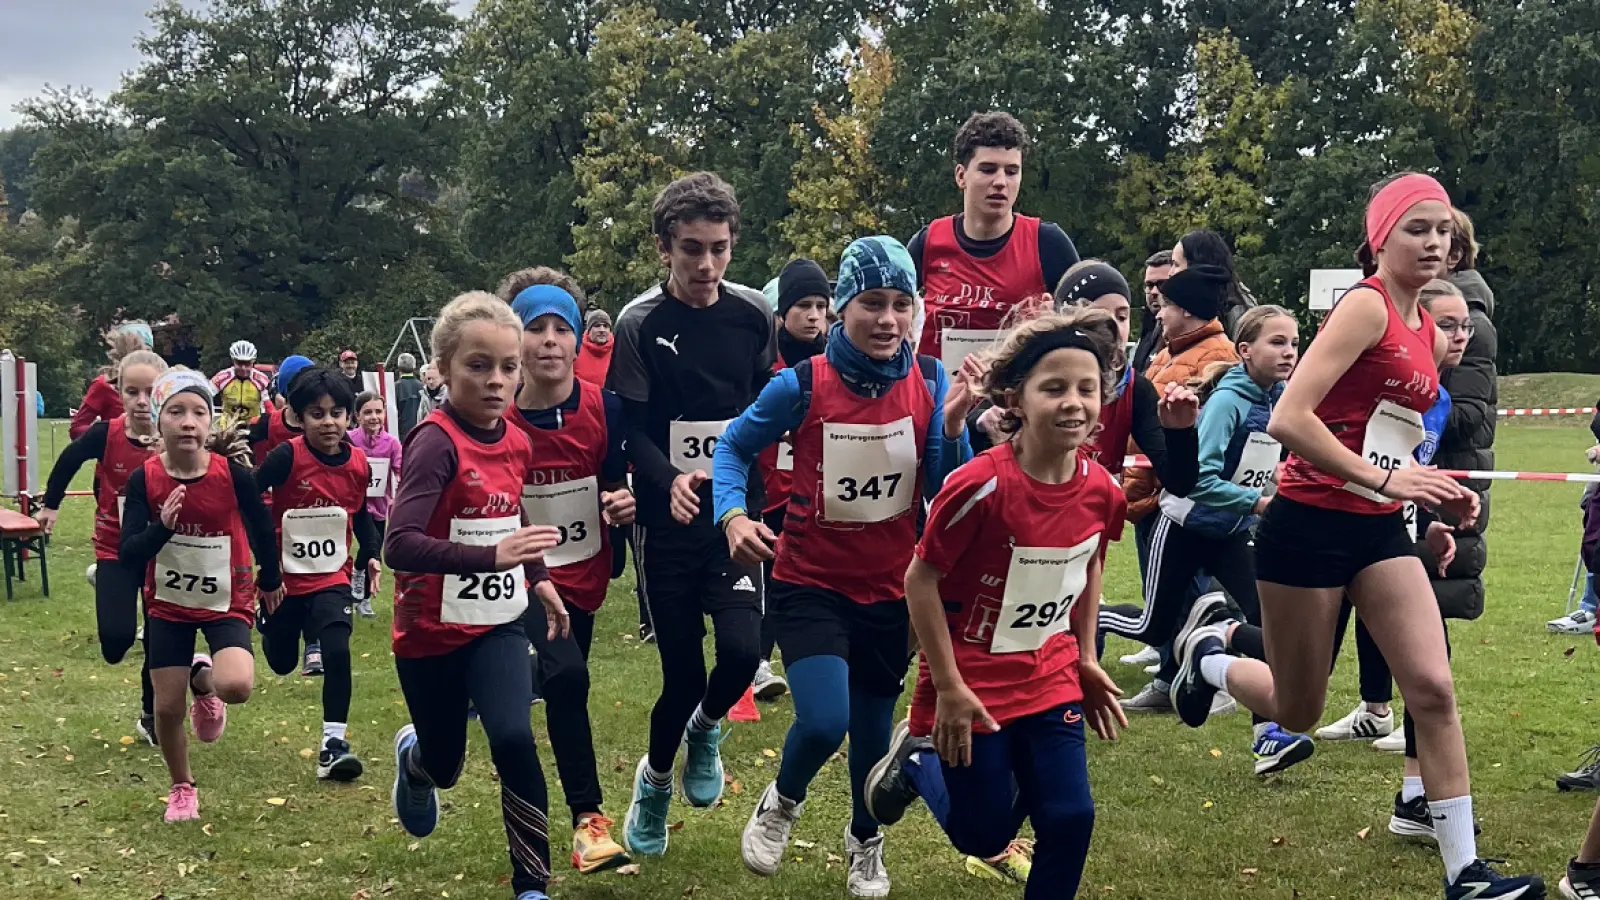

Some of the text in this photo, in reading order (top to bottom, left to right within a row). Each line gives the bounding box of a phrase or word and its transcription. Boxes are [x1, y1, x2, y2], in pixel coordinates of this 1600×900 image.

[960, 283, 995, 303] DJK
[683, 435, 718, 459] 30
[532, 469, 575, 485] DJK
[837, 472, 903, 502] 347
[292, 539, 336, 558] 300
[165, 570, 218, 594] 275
[457, 572, 515, 601] 269
[1010, 594, 1074, 628] 292
